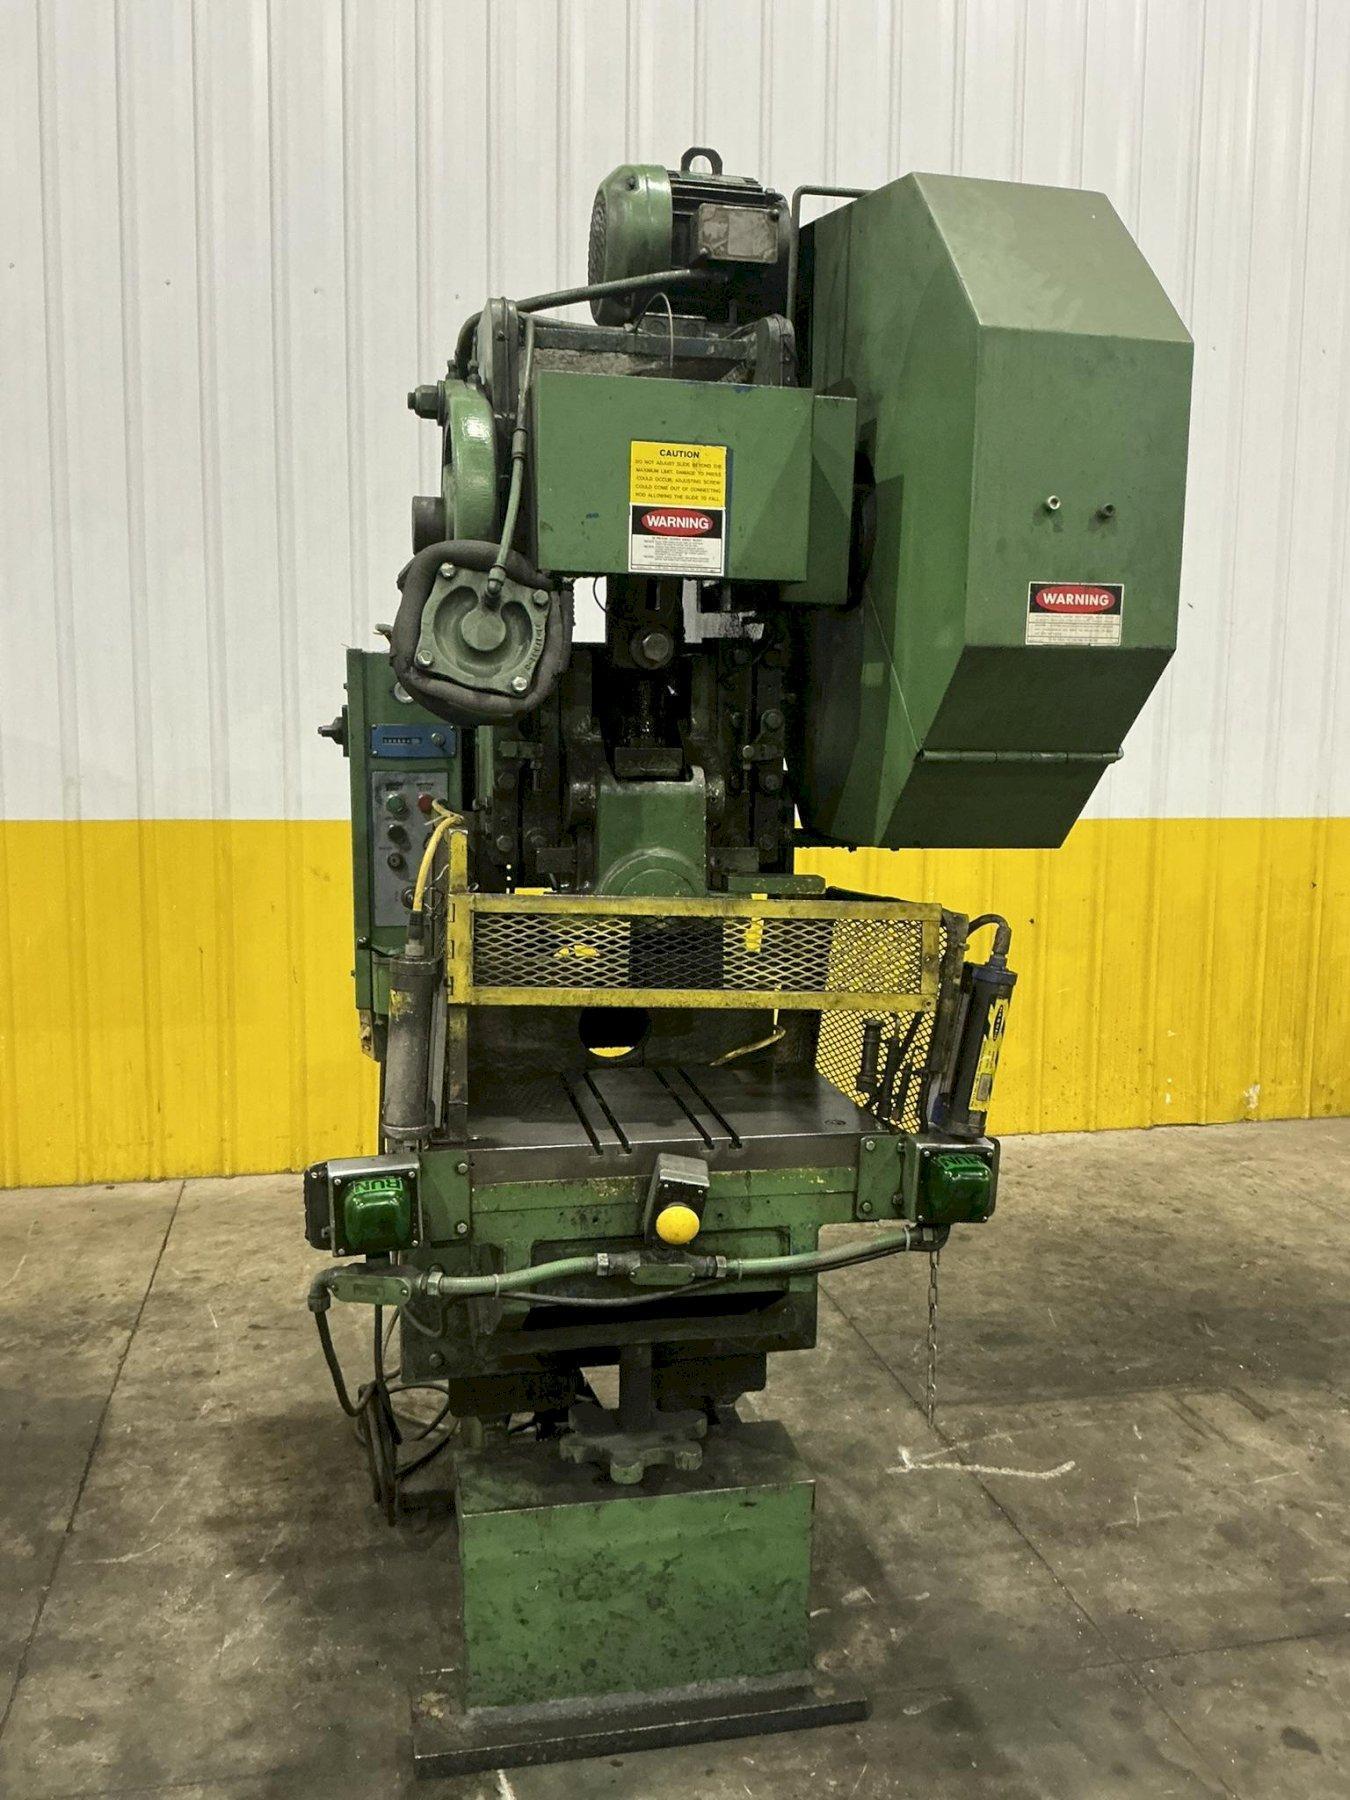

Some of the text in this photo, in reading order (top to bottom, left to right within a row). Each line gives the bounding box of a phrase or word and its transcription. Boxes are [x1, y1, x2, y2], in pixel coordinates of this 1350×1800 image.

[659, 449, 700, 459] CAUTION
[647, 515, 710, 530] WARNING
[1042, 593, 1110, 607] WARNING
[354, 1179, 401, 1194] RUN
